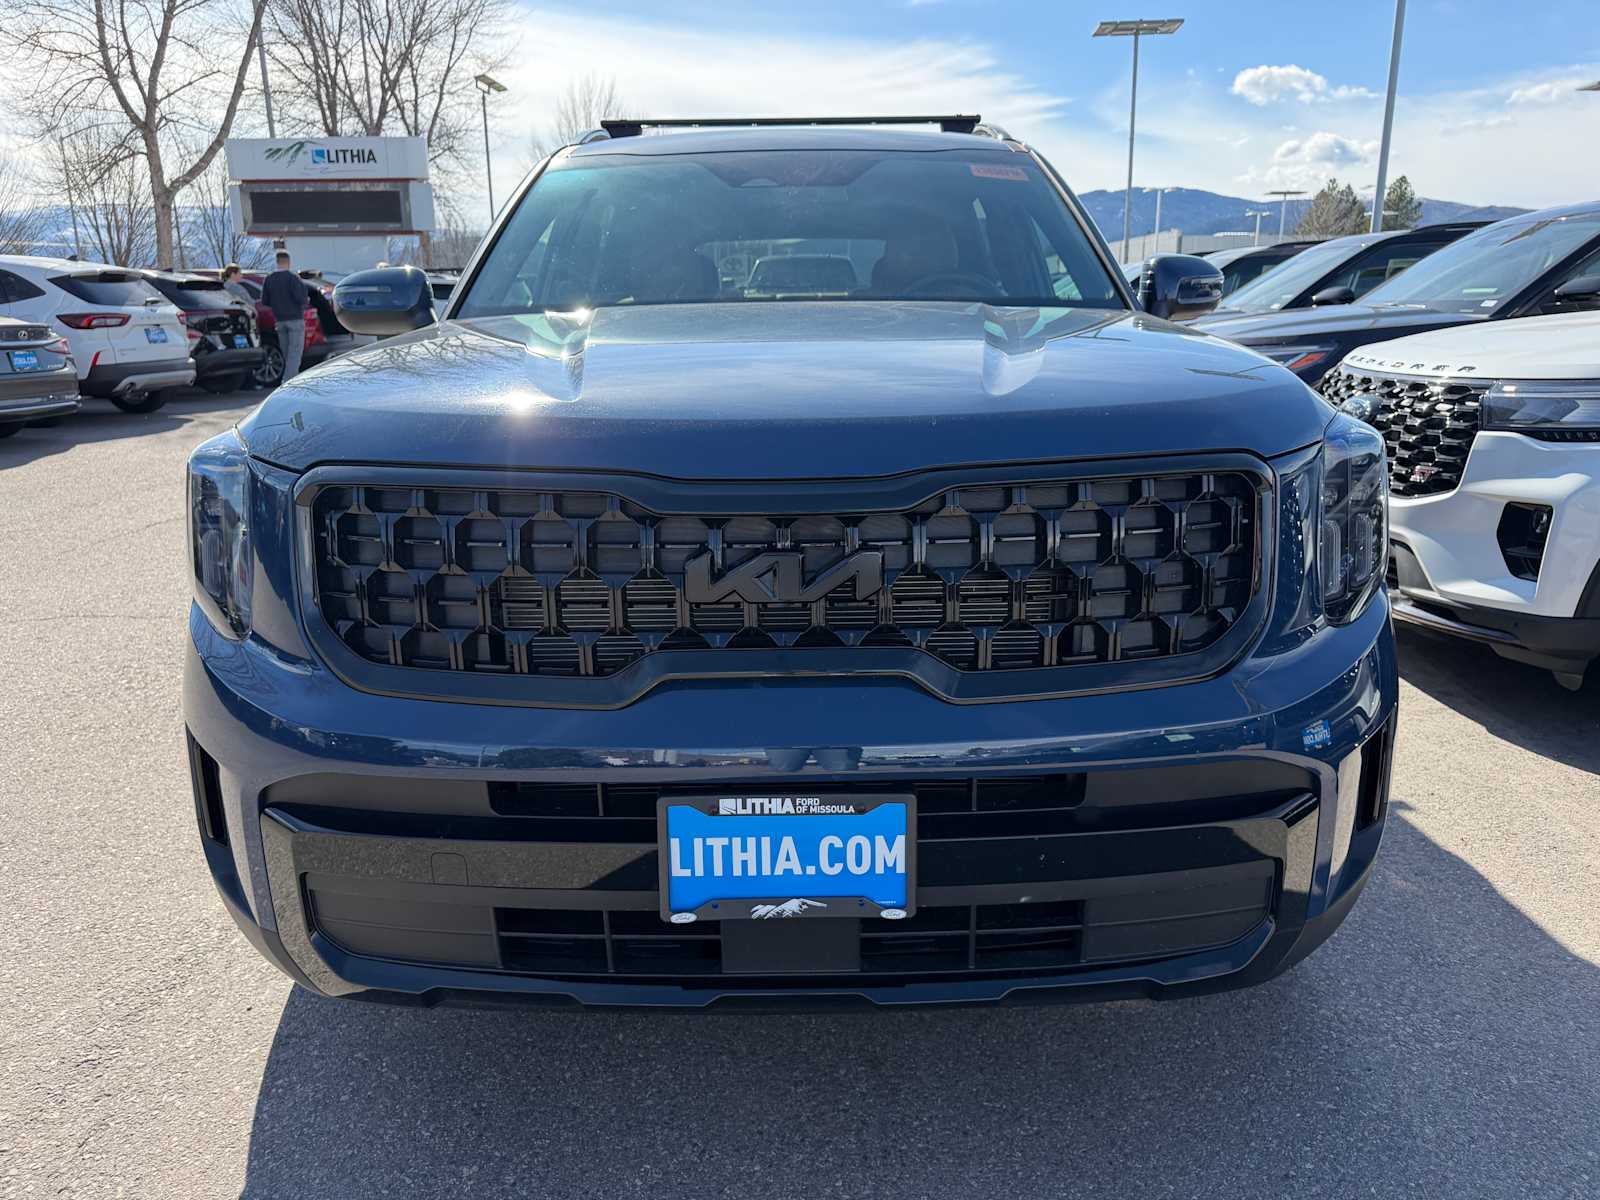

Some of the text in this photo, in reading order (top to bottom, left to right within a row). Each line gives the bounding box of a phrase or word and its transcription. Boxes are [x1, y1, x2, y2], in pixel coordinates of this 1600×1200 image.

[327, 149, 377, 164] LITHIA
[737, 798, 796, 814] LITHIA
[796, 798, 820, 806] FORD
[796, 805, 855, 814] OF MISSOULA
[670, 835, 906, 877] LITHIA.COM
